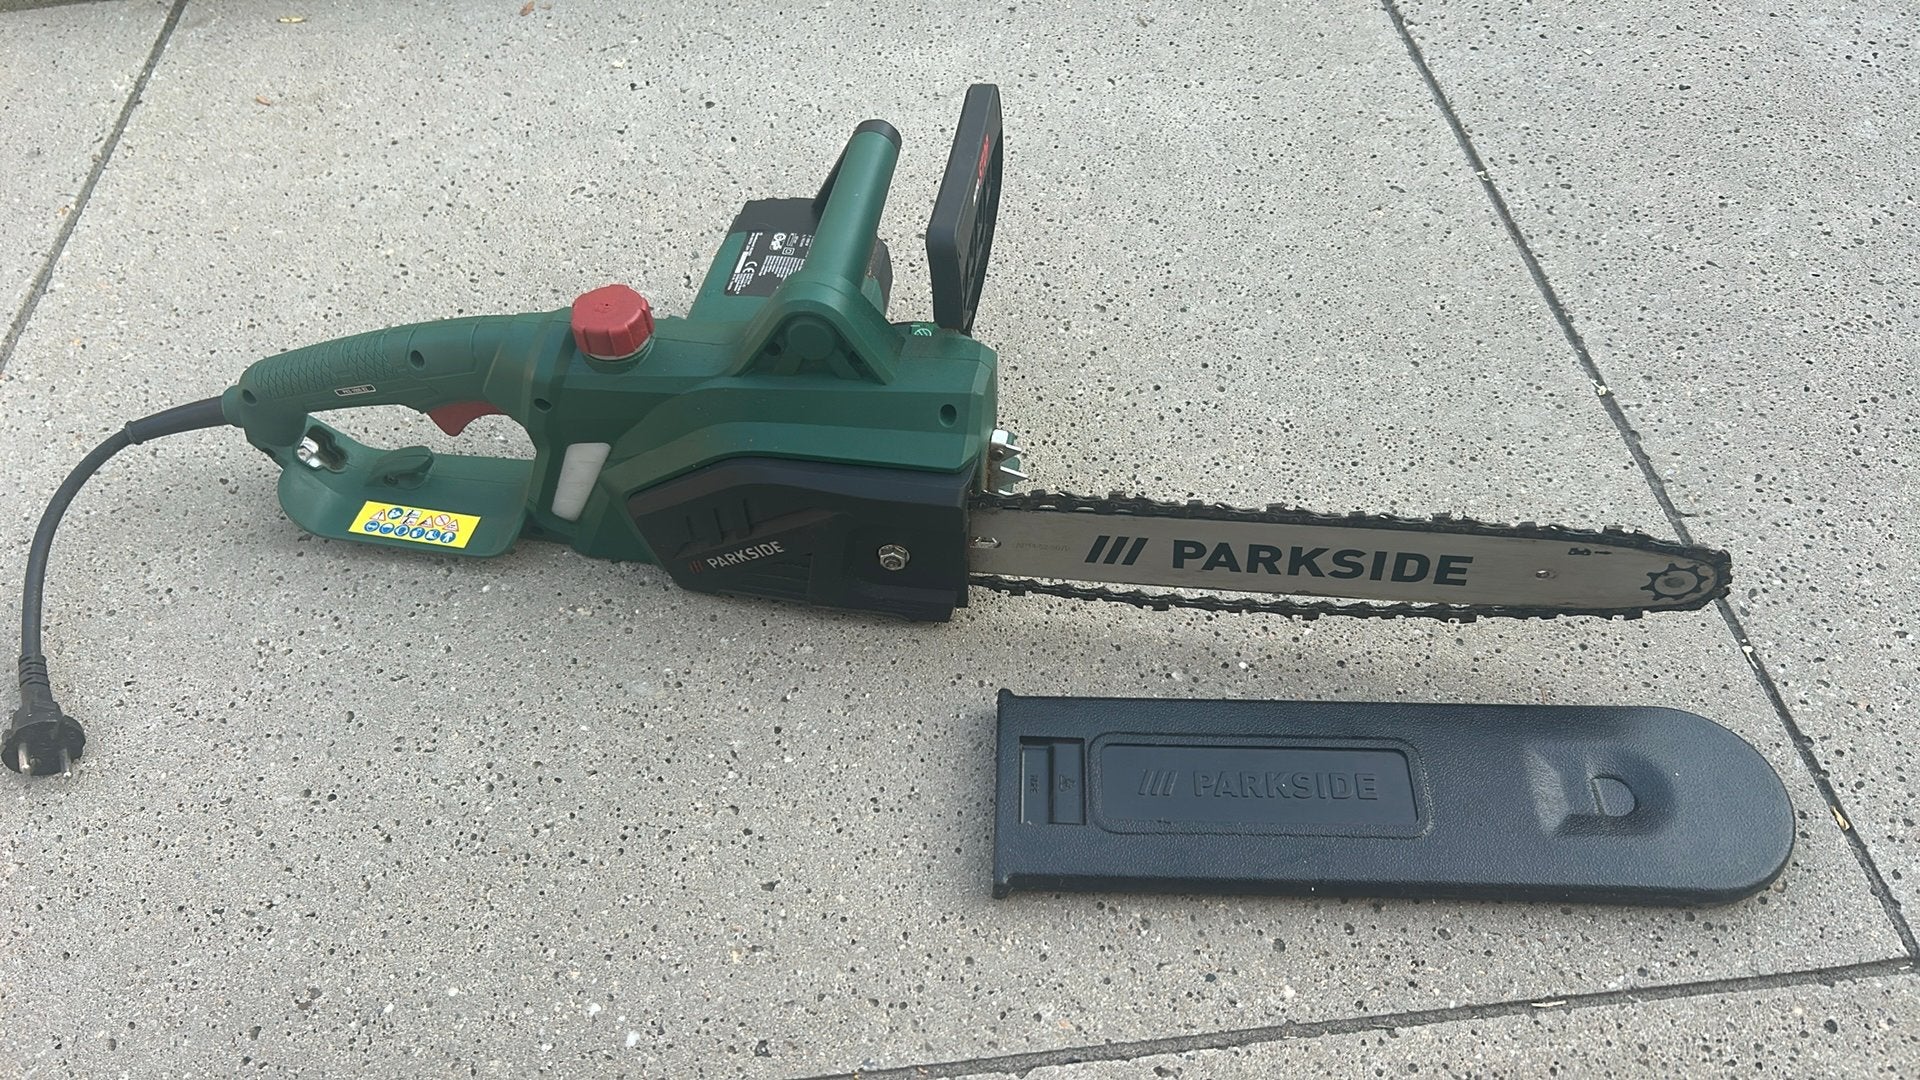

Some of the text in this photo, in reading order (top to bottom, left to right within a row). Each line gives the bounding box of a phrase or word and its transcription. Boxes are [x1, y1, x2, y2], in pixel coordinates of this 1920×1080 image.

[706, 541, 785, 569] PARKSIDE
[1172, 539, 1474, 587] PARKSIDE
[1192, 770, 1379, 801] PARKSIDE
